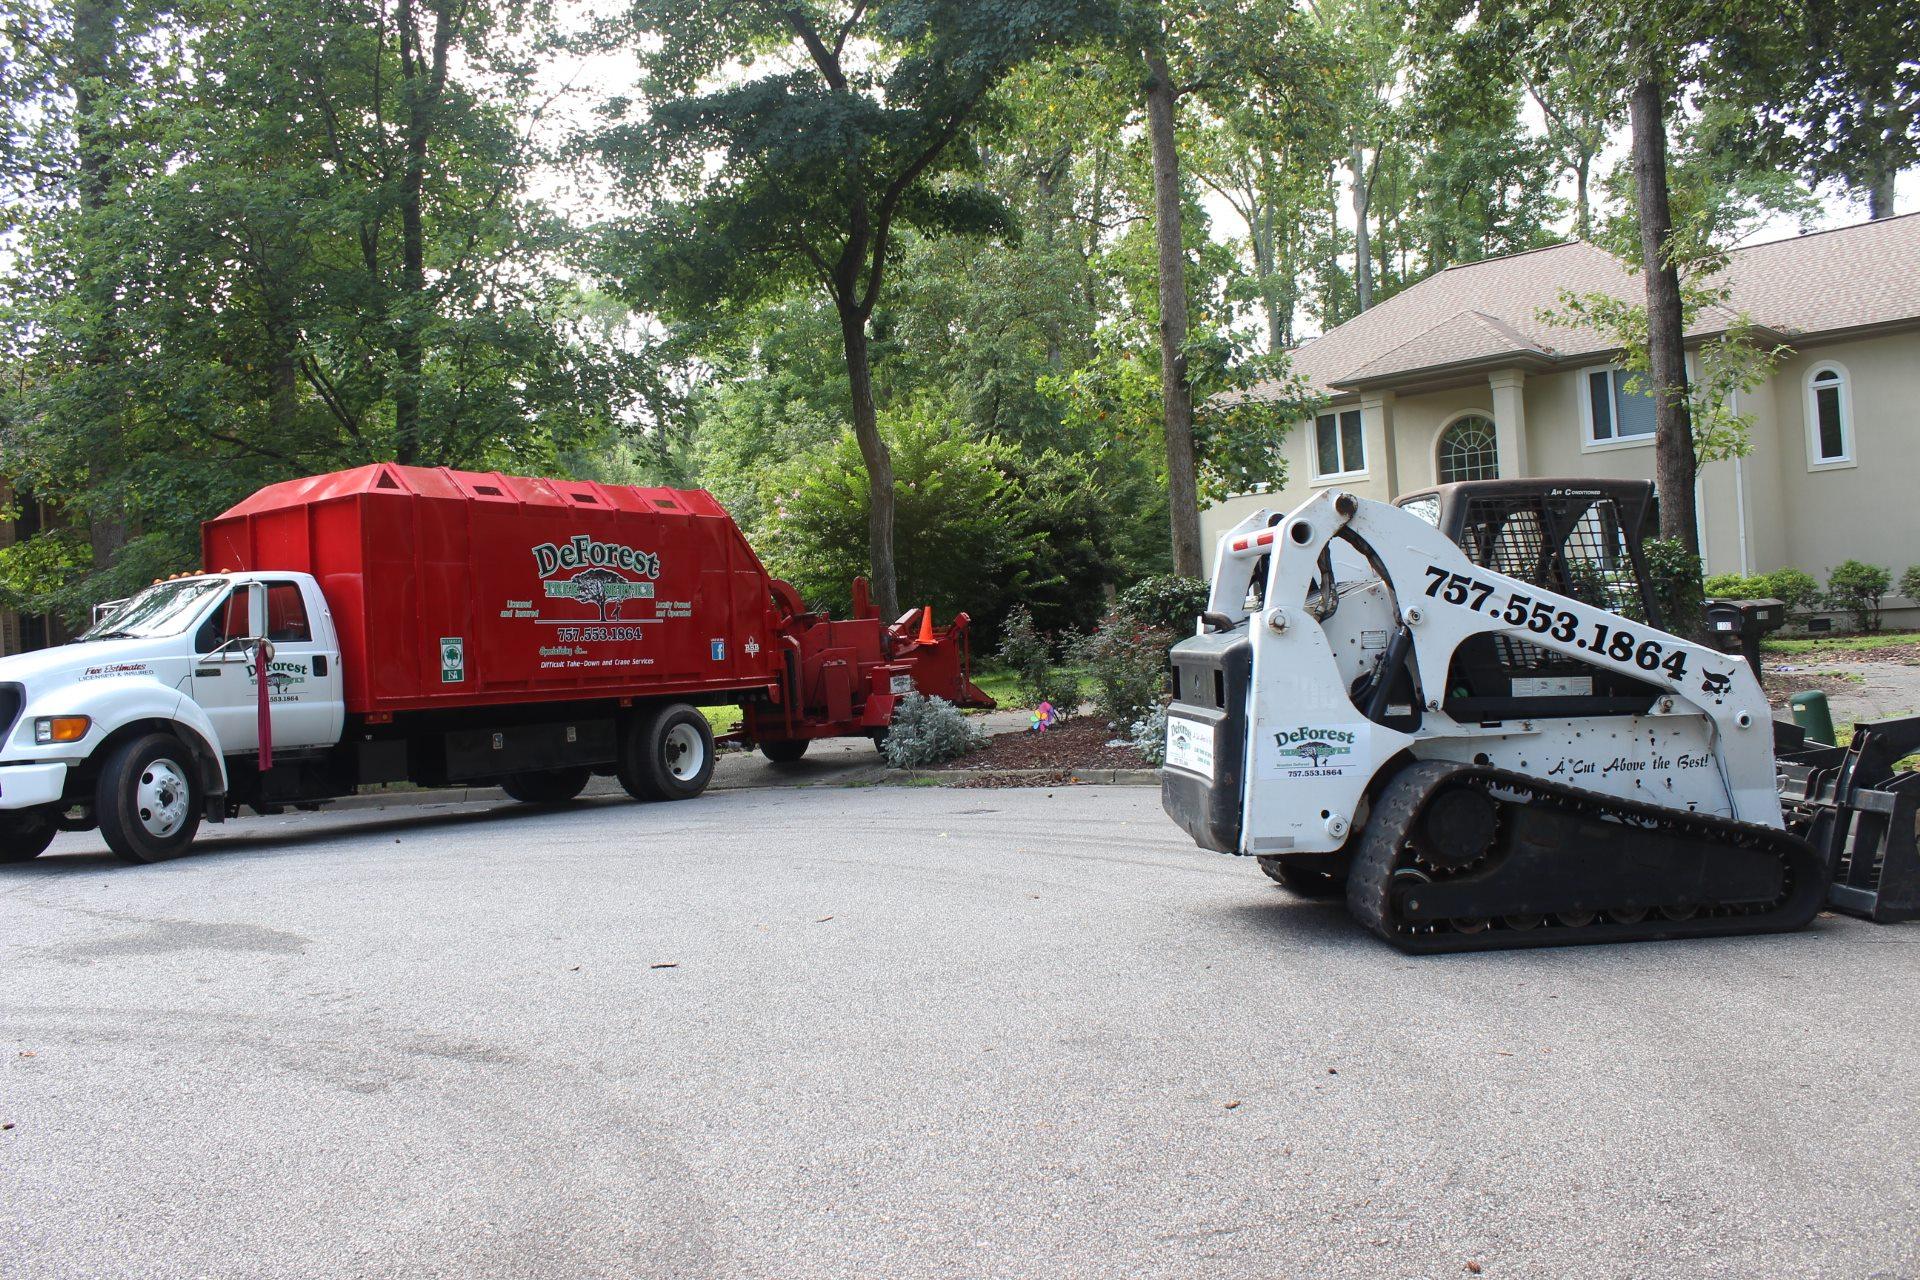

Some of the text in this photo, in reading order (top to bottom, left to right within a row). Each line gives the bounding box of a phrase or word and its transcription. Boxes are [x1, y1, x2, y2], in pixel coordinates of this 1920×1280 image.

[532, 535, 661, 579] DeForest
[544, 580, 582, 598] TREE
[1424, 565, 1688, 682] 757.553.1864
[557, 626, 643, 642] 757.553.1864
[104, 663, 147, 673] Estimates
[246, 662, 308, 677] DForest
[566, 660, 600, 668] Take-Down
[78, 673, 115, 682] LICENSED
[124, 669, 155, 677] INSURED
[1273, 726, 1355, 747] DeForest
[1548, 754, 1709, 775] A Cut Above the Best!
[1288, 769, 1342, 777] 757.553.1864
